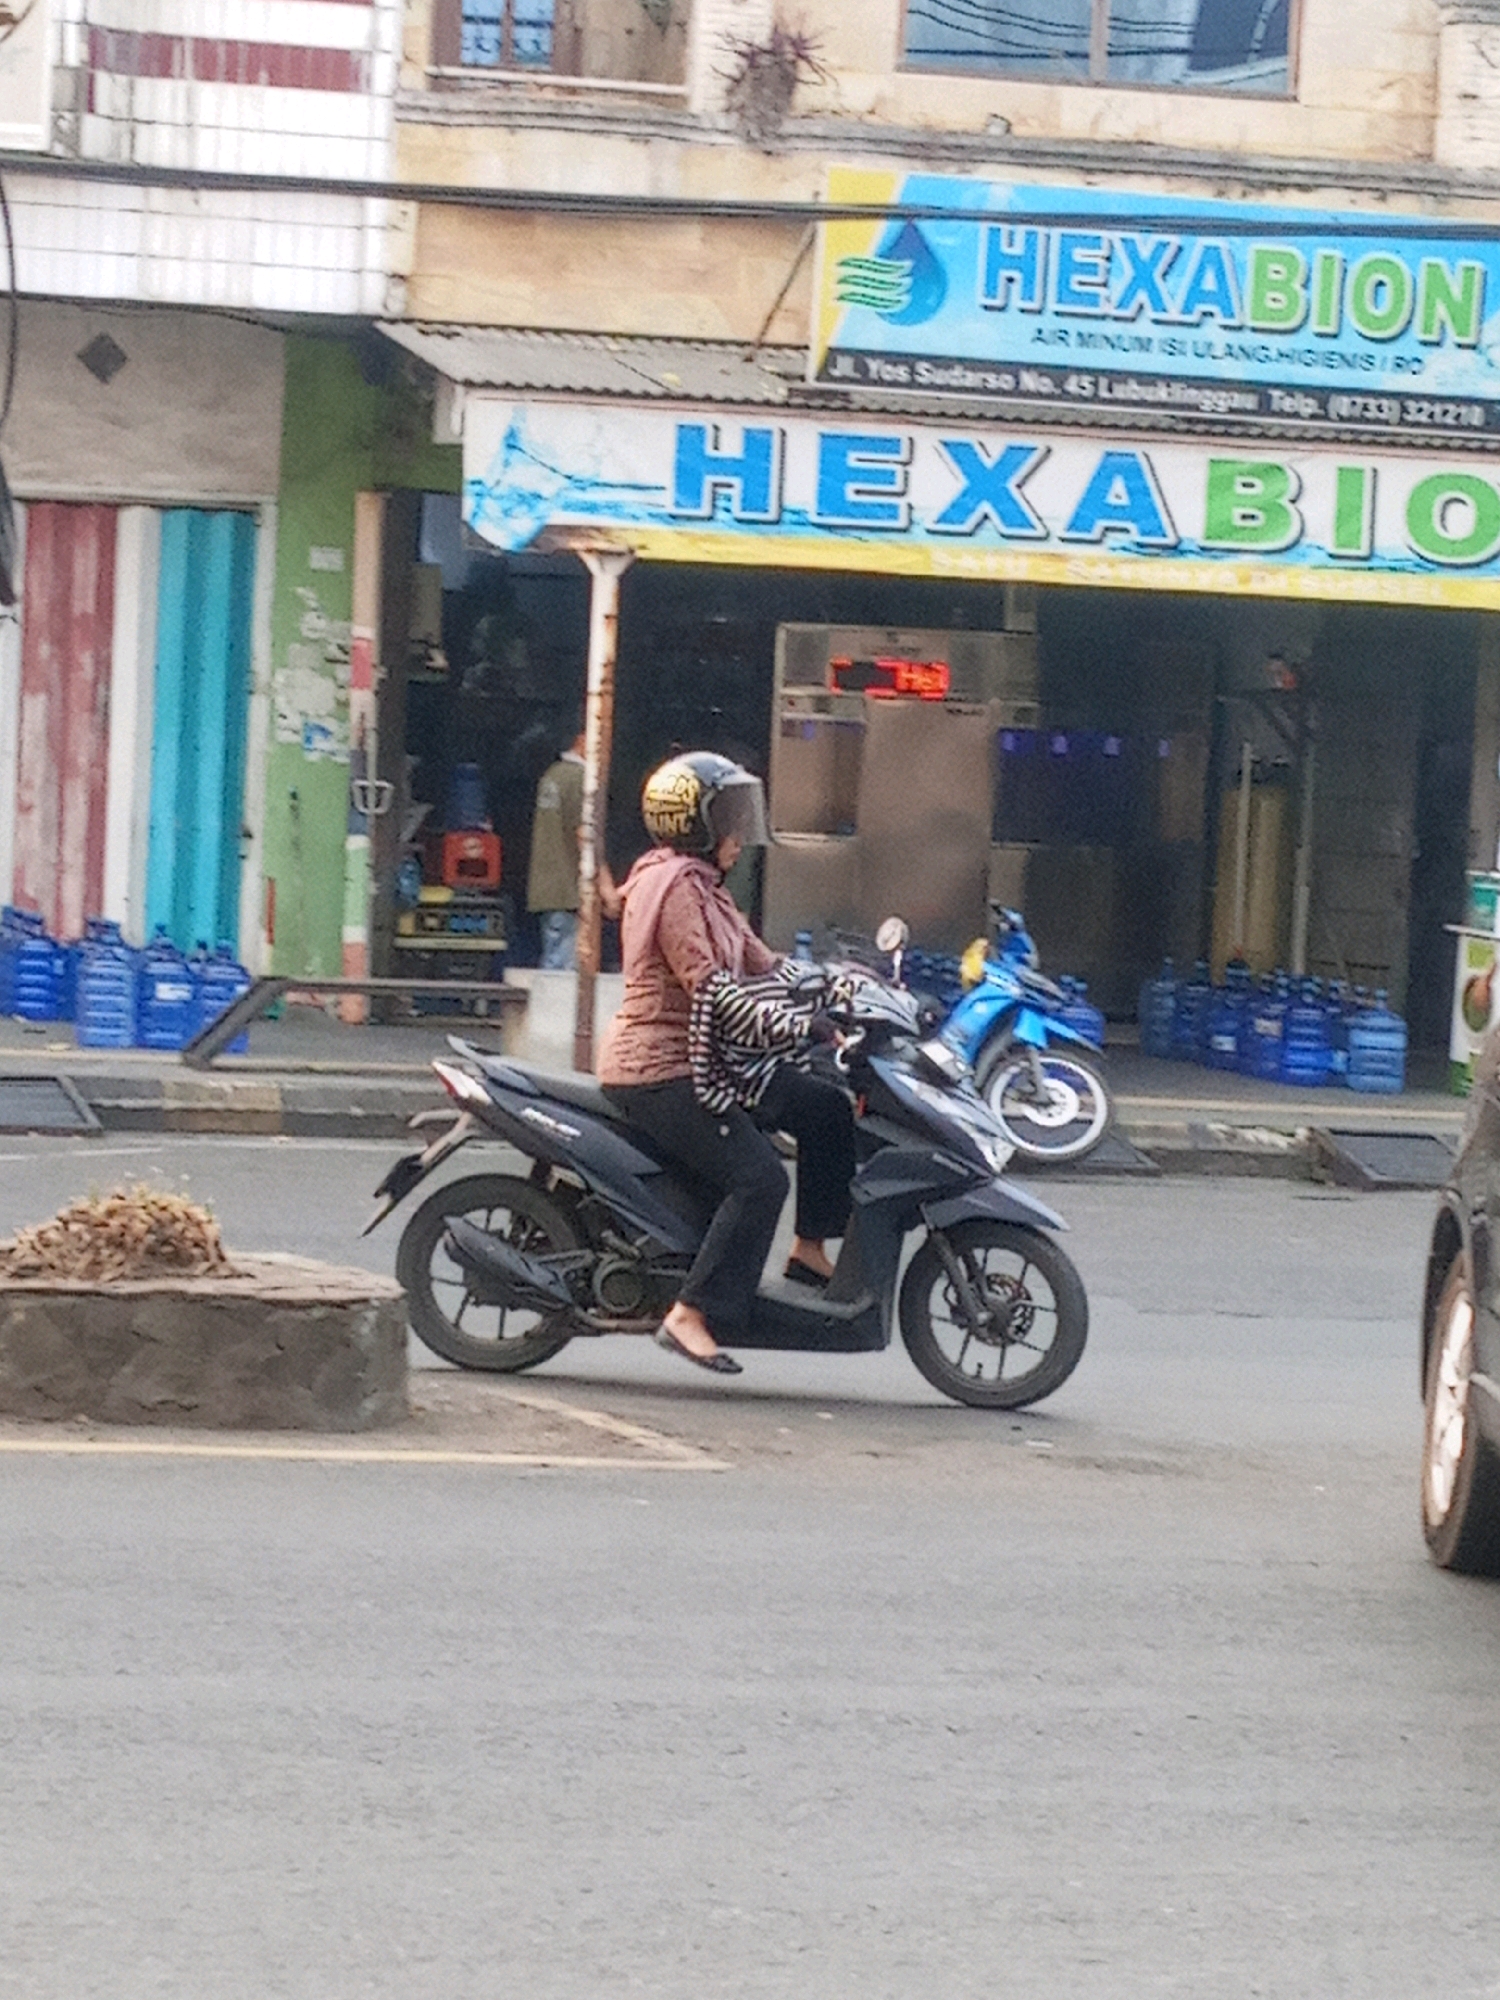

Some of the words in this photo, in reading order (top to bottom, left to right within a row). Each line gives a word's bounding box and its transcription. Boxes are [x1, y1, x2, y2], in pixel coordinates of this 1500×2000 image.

[978, 221, 1486, 349] HEXABION
[1030, 326, 1071, 346] AIR
[1076, 330, 1152, 352] MINUM
[864, 356, 913, 383] Yos
[913, 360, 1016, 391] Sudarso
[1017, 368, 1062, 395] No.
[1063, 373, 1096, 398] 45
[1267, 388, 1326, 419] Telp.
[670, 421, 1500, 569] HEXABIO
